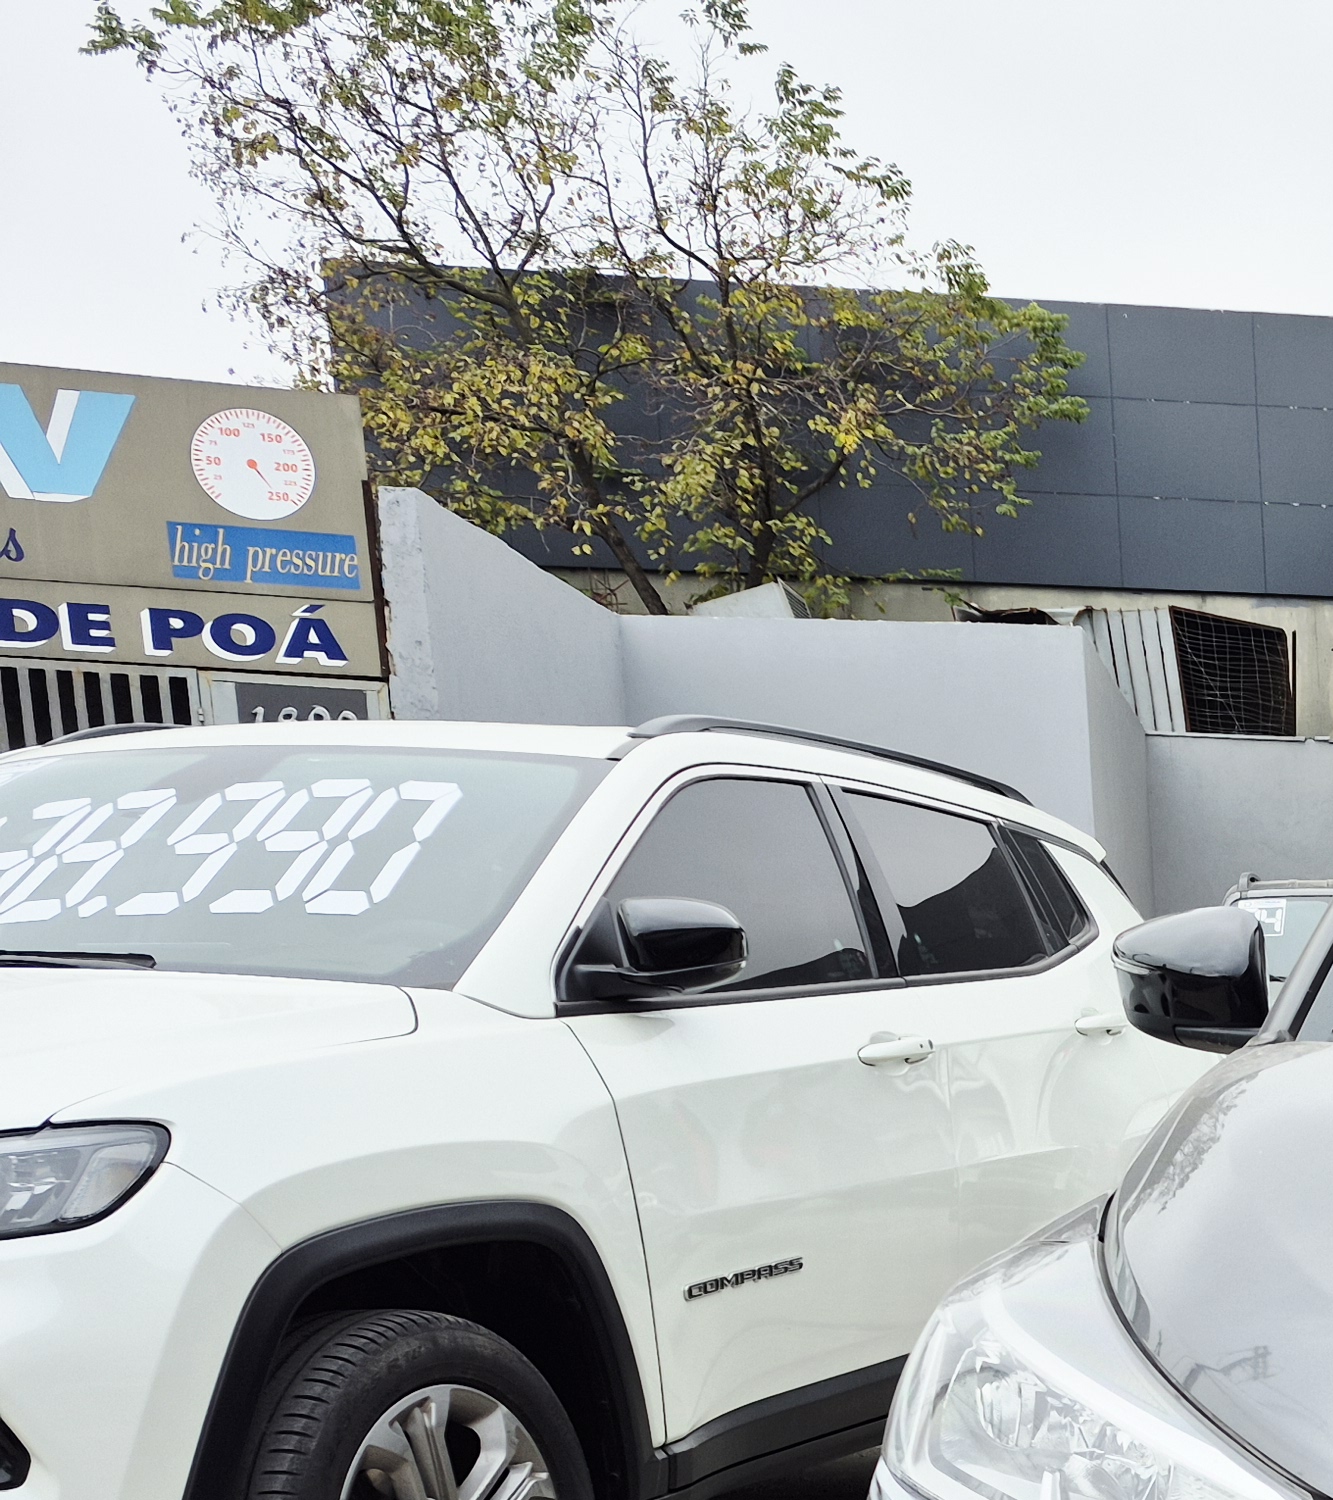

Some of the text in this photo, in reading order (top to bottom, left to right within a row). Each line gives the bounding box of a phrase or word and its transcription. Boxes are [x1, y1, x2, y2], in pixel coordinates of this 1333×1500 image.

[218, 427, 241, 438] 100
[260, 432, 283, 444] 150
[205, 456, 222, 466] 50
[274, 462, 298, 473] 200
[267, 491, 290, 502] 250
[173, 525, 358, 583] high pressure
[0, 598, 348, 666] DE POÁ
[0, 778, 463, 925] 38.990
[684, 1256, 803, 1301] COMPASS
